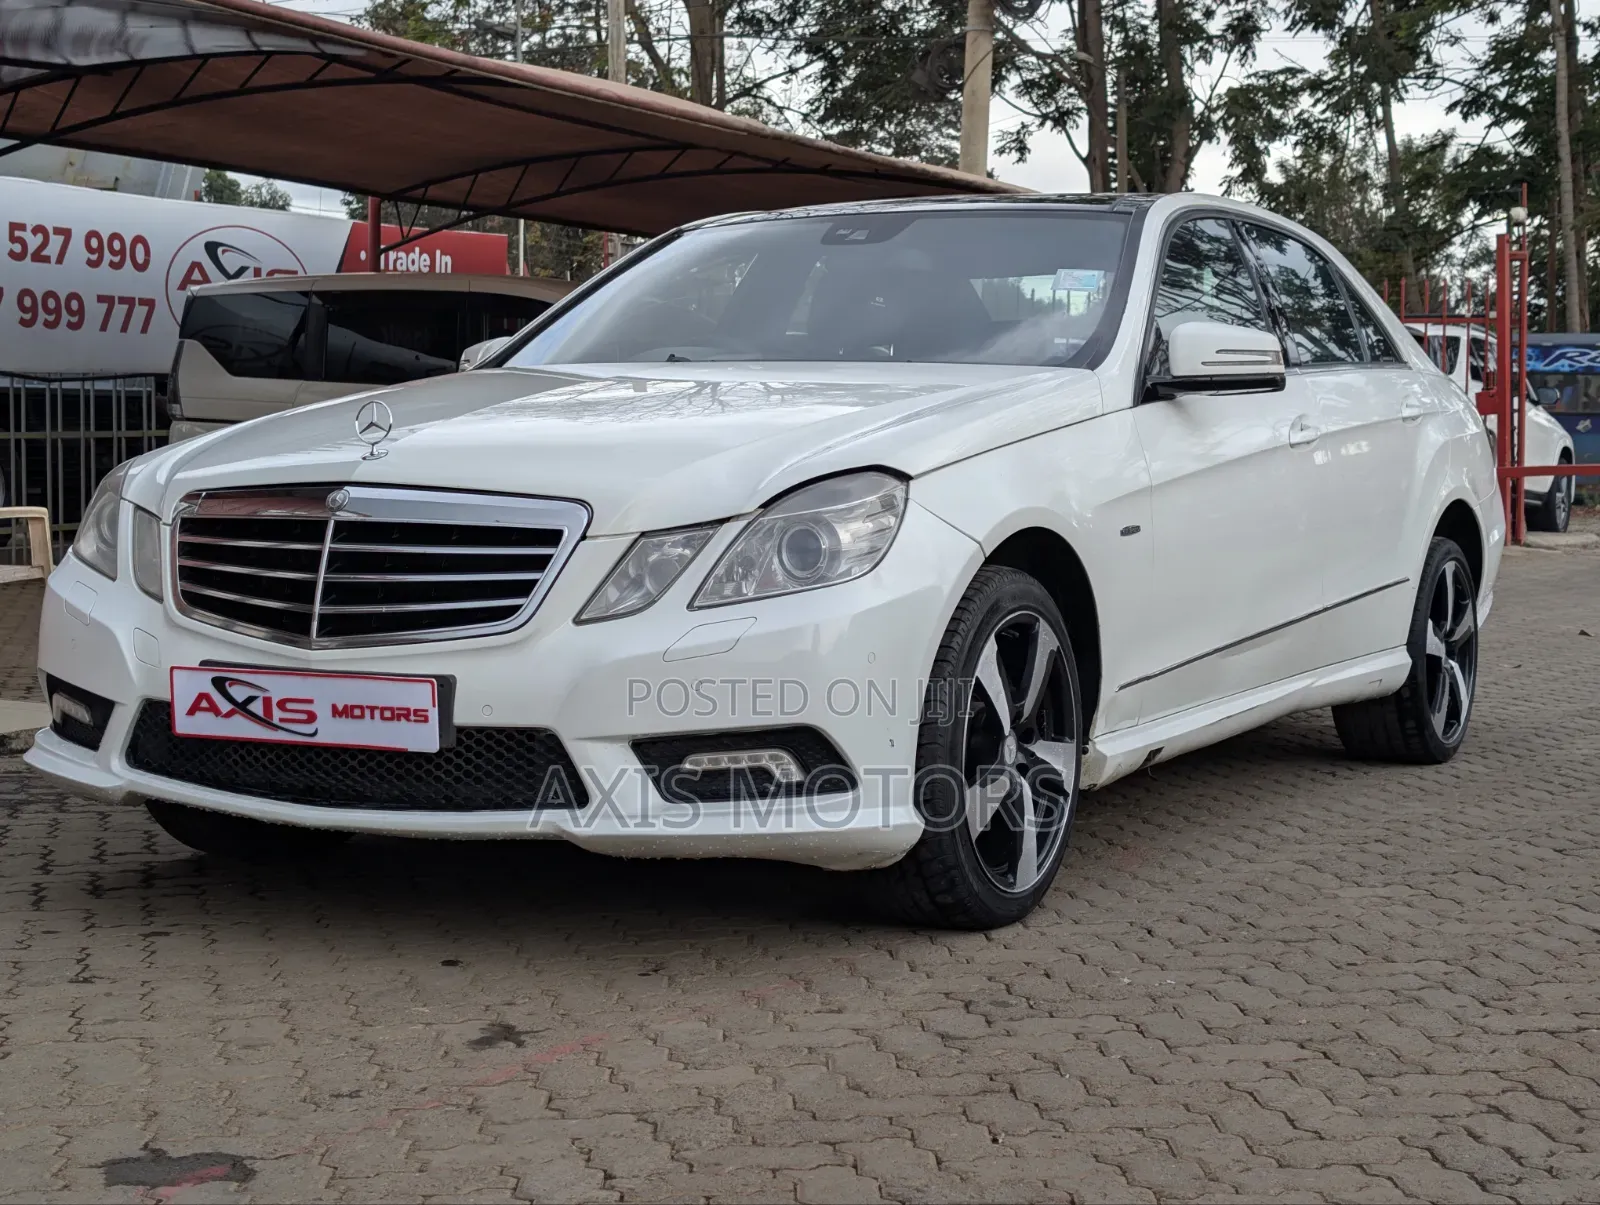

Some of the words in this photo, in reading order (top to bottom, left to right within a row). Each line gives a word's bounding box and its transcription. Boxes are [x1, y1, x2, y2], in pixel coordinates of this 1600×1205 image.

[7, 221, 72, 265] 527
[84, 229, 151, 273] 990
[436, 249, 452, 274] In
[16, 288, 86, 331] 999
[96, 294, 156, 334] 777
[185, 679, 318, 735] AXIS
[331, 703, 430, 723] MOTORS
